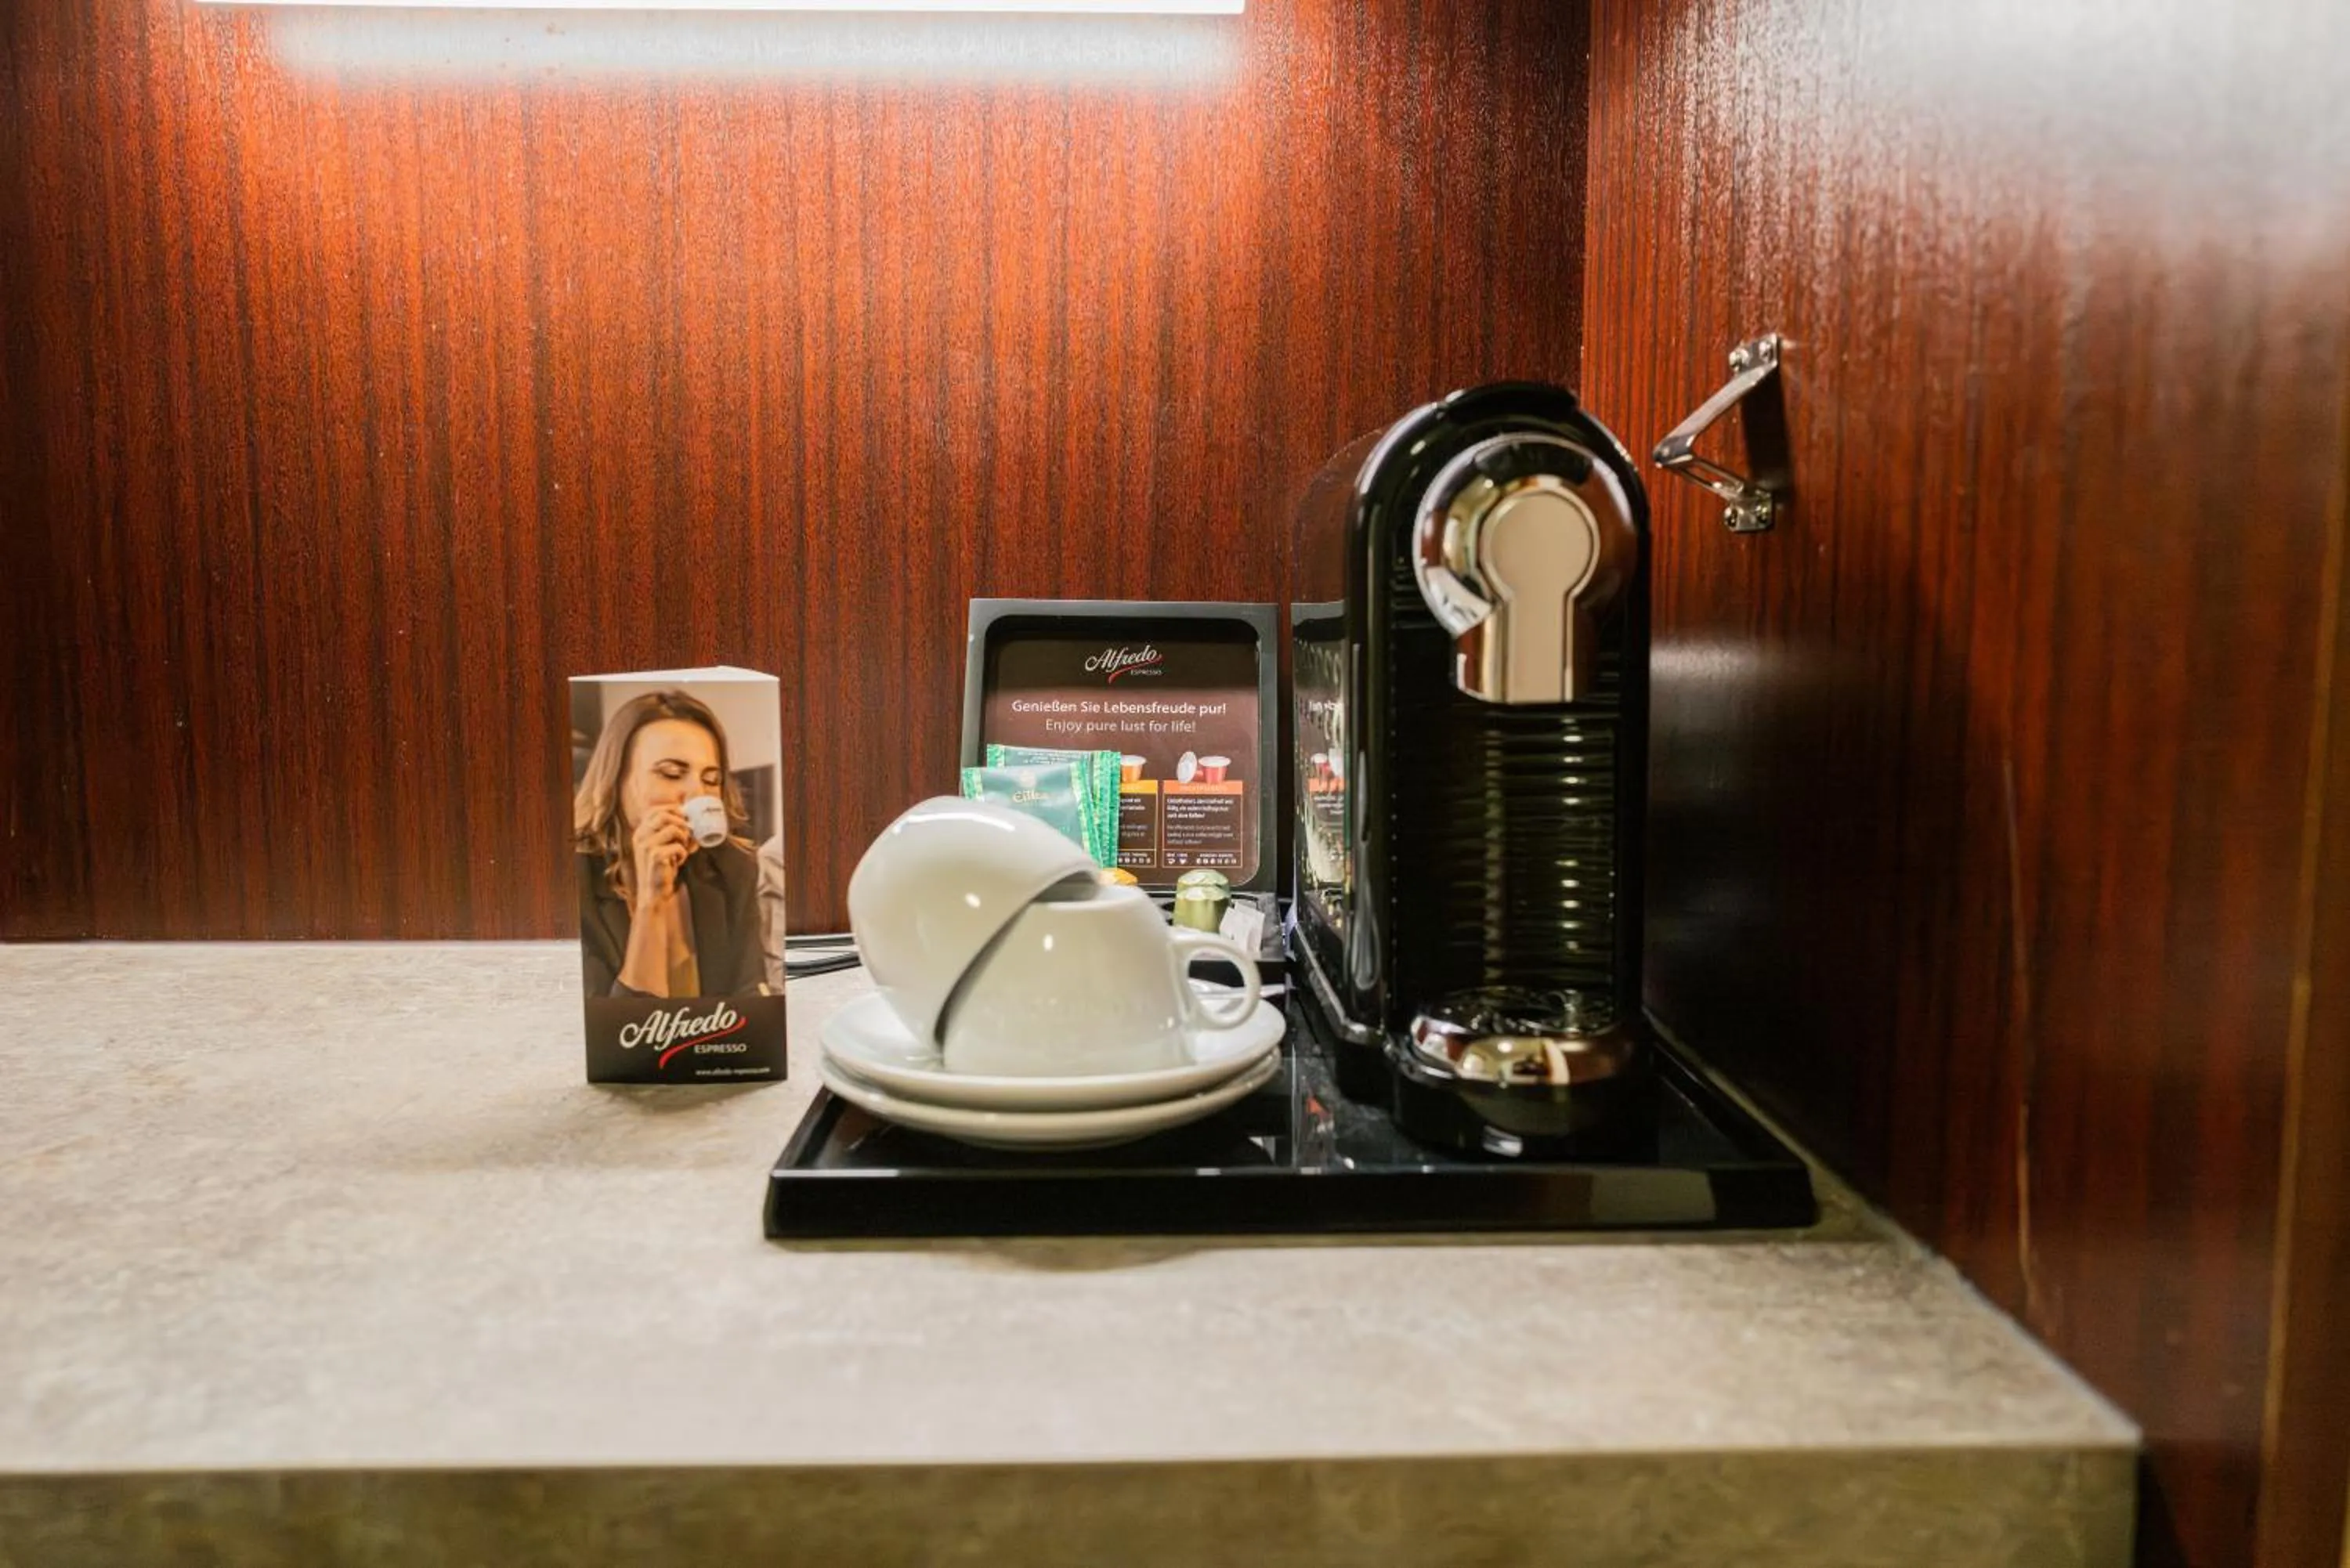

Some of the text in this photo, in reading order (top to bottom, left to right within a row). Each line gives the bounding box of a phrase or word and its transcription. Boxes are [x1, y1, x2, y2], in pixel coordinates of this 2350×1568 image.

[1085, 645, 1157, 673] Alfredo
[1011, 699, 1227, 717] Genießen Sie Lebensfreude pur!
[1046, 718, 1196, 733] Enjoy pure lust for life!
[620, 1002, 737, 1050] Alfredo
[694, 1043, 747, 1053] ESPRESSO
